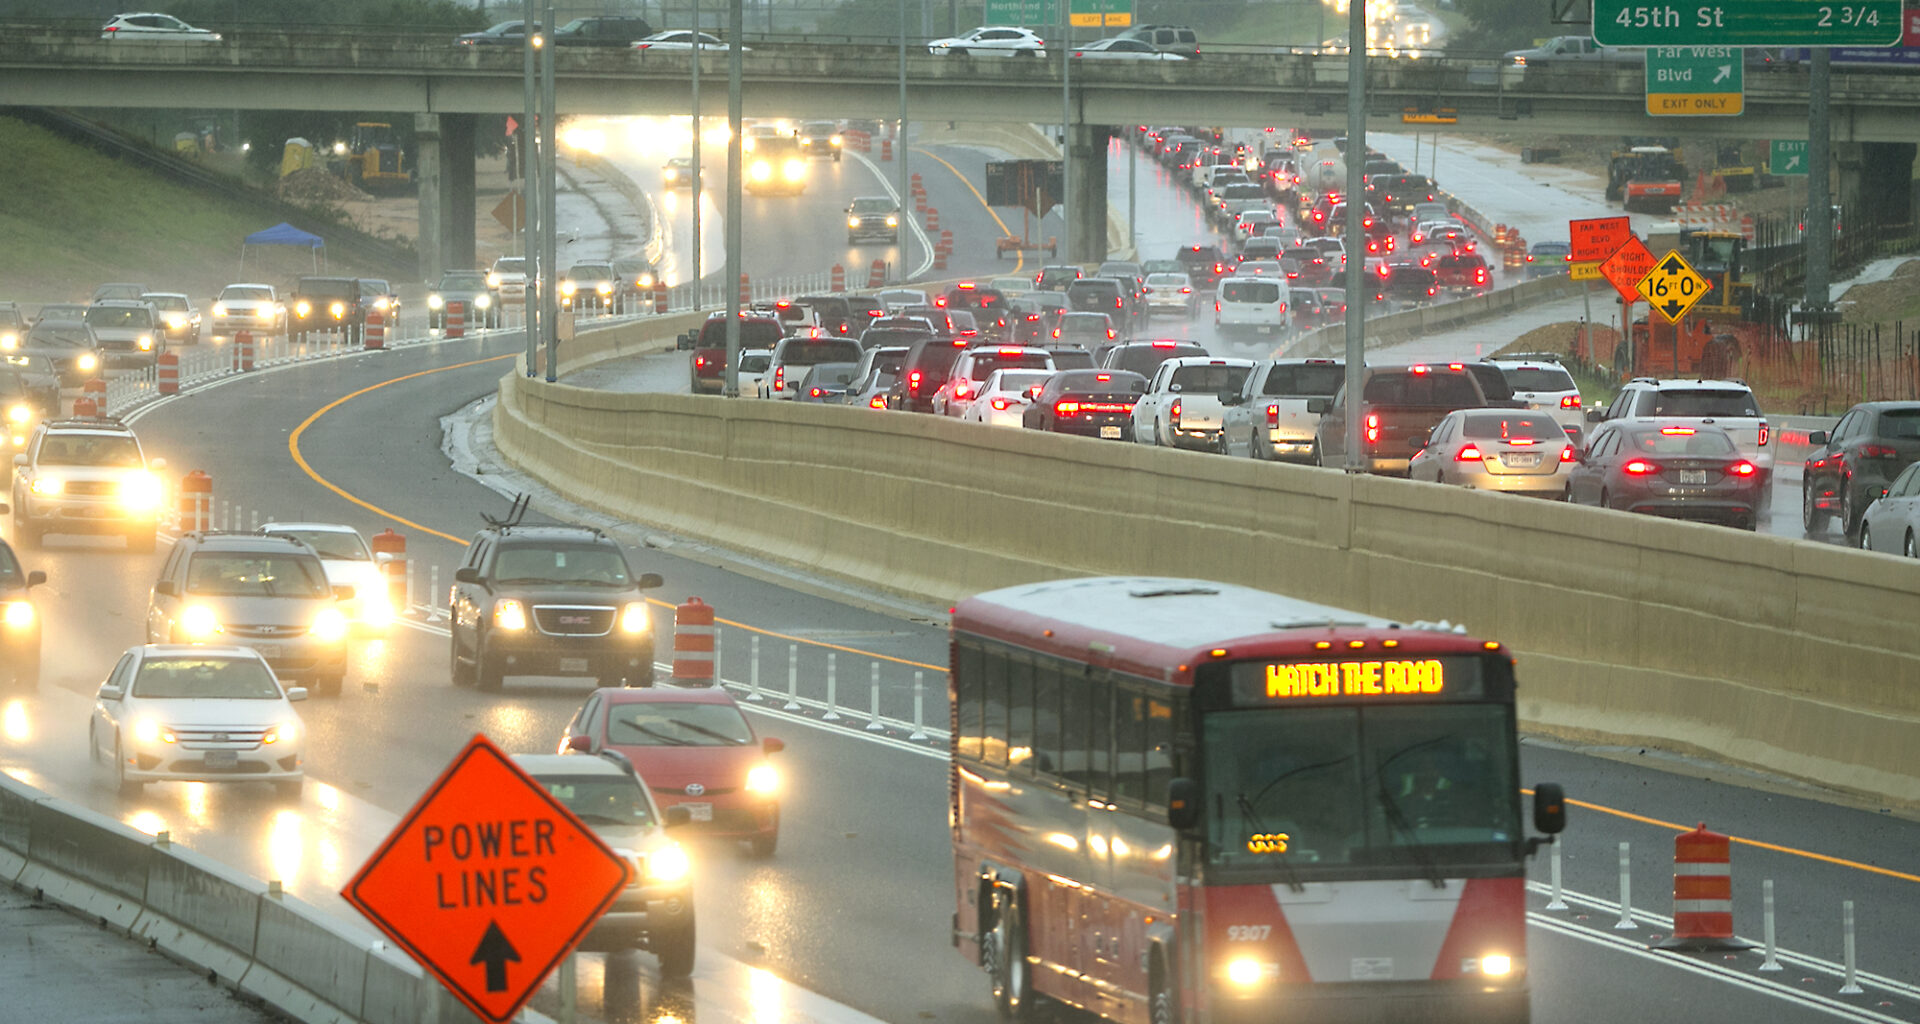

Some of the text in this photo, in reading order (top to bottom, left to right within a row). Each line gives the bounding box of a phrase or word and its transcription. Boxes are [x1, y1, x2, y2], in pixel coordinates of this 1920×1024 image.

[1615, 6, 1724, 28] 45th St
[1818, 6, 1879, 27] 2 3/4
[1657, 47, 1731, 58] Far West
[1657, 68, 1692, 81] Blvd
[1662, 99, 1726, 109] EXIT ONLY
[1779, 142, 1806, 151] EXIT
[1580, 222, 1619, 232] FAR WEST
[1591, 236, 1610, 244] BLVD
[1577, 247, 1617, 256] RIGHT LA
[1621, 252, 1645, 261] RIGHT
[1578, 266, 1598, 275] EXIT
[1616, 278, 1640, 287] CLOS
[1648, 278, 1668, 297] 16
[1669, 282, 1677, 290] FT
[1681, 276, 1694, 296] 0
[560, 616, 591, 624] GMC
[1266, 660, 1443, 697] WATCH THE ROAD
[424, 820, 555, 861] POWER
[437, 868, 547, 909] LINES
[1228, 925, 1271, 941] 9307
